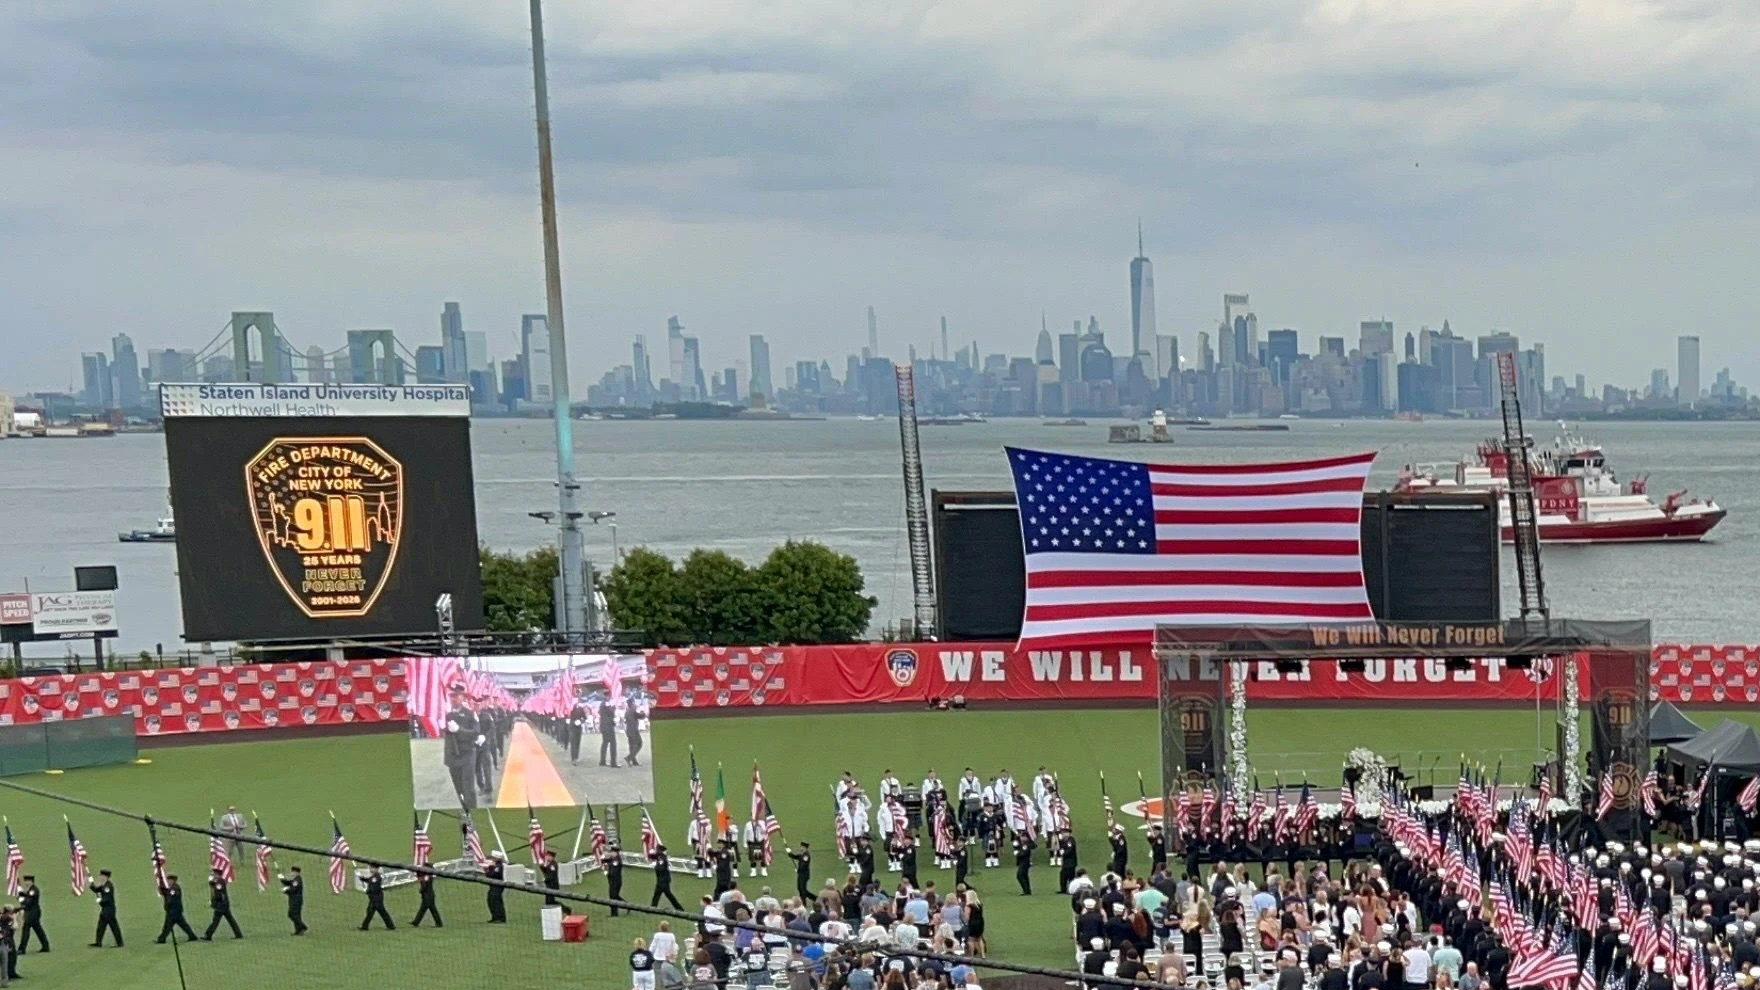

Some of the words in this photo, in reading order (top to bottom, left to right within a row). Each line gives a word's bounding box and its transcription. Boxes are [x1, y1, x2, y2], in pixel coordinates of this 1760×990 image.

[200, 385, 254, 399] Staten
[261, 386, 309, 399] Island
[315, 384, 397, 402] University
[403, 386, 470, 402] Hospital
[201, 403, 280, 416] Northwell
[286, 403, 336, 416] Health
[259, 456, 290, 483] FIRE
[290, 446, 391, 480] DEPARTMENT
[298, 467, 329, 478] CITY
[333, 467, 352, 477] OF
[289, 480, 321, 490] NEW
[324, 479, 363, 490] YORK
[1541, 499, 1574, 508] FDNY
[321, 555, 362, 565] YEARS
[305, 568, 362, 580] NEVER
[302, 579, 366, 593] FORGET
[1312, 627, 1339, 645] We
[1347, 626, 1381, 644] Will
[1387, 625, 1438, 644] Never
[1445, 625, 1504, 644] Forget
[939, 651, 1005, 681] WE
[1028, 651, 1142, 681] WILL
